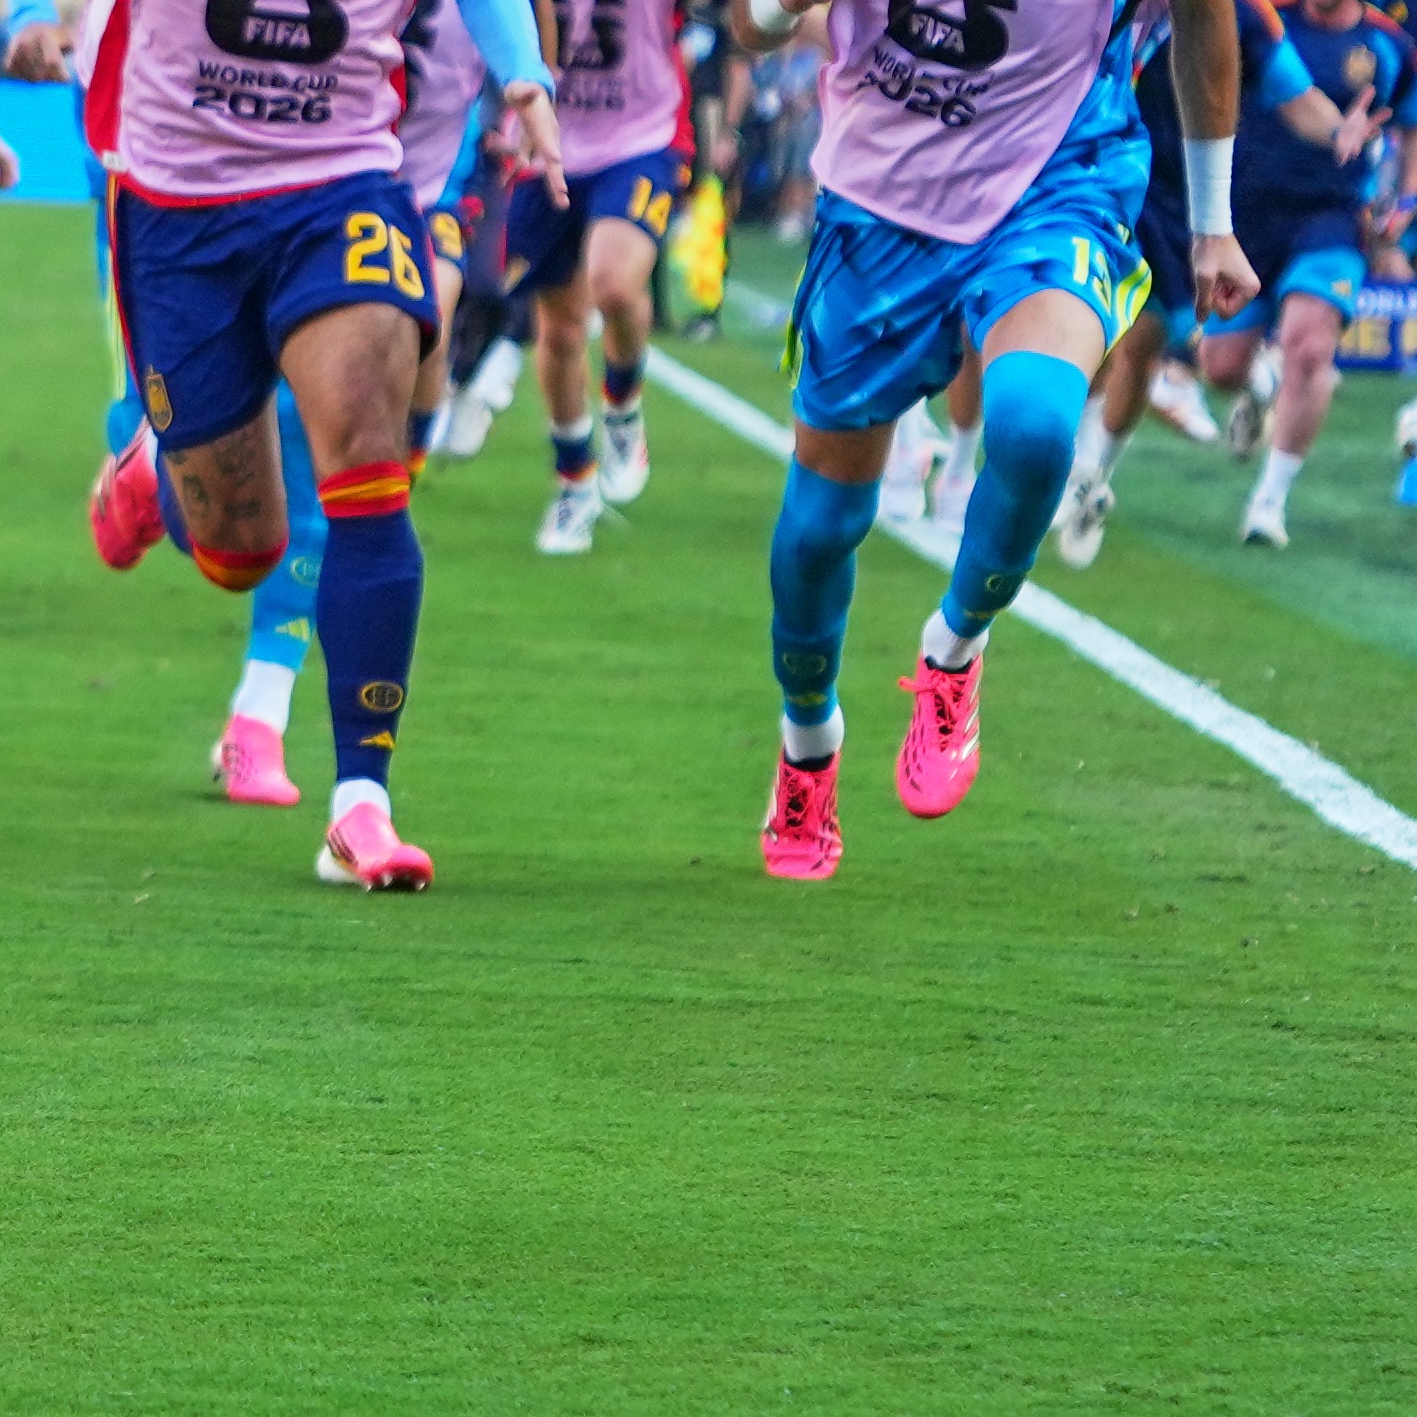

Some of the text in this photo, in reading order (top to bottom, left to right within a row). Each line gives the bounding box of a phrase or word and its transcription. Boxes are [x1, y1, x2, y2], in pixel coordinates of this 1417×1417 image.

[245, 15, 312, 49] FIFA
[909, 12, 966, 54] FIFA
[198, 58, 339, 93] WORLD CUP
[193, 85, 333, 124] 2026
[628, 175, 673, 237] 14
[346, 212, 425, 299] 26
